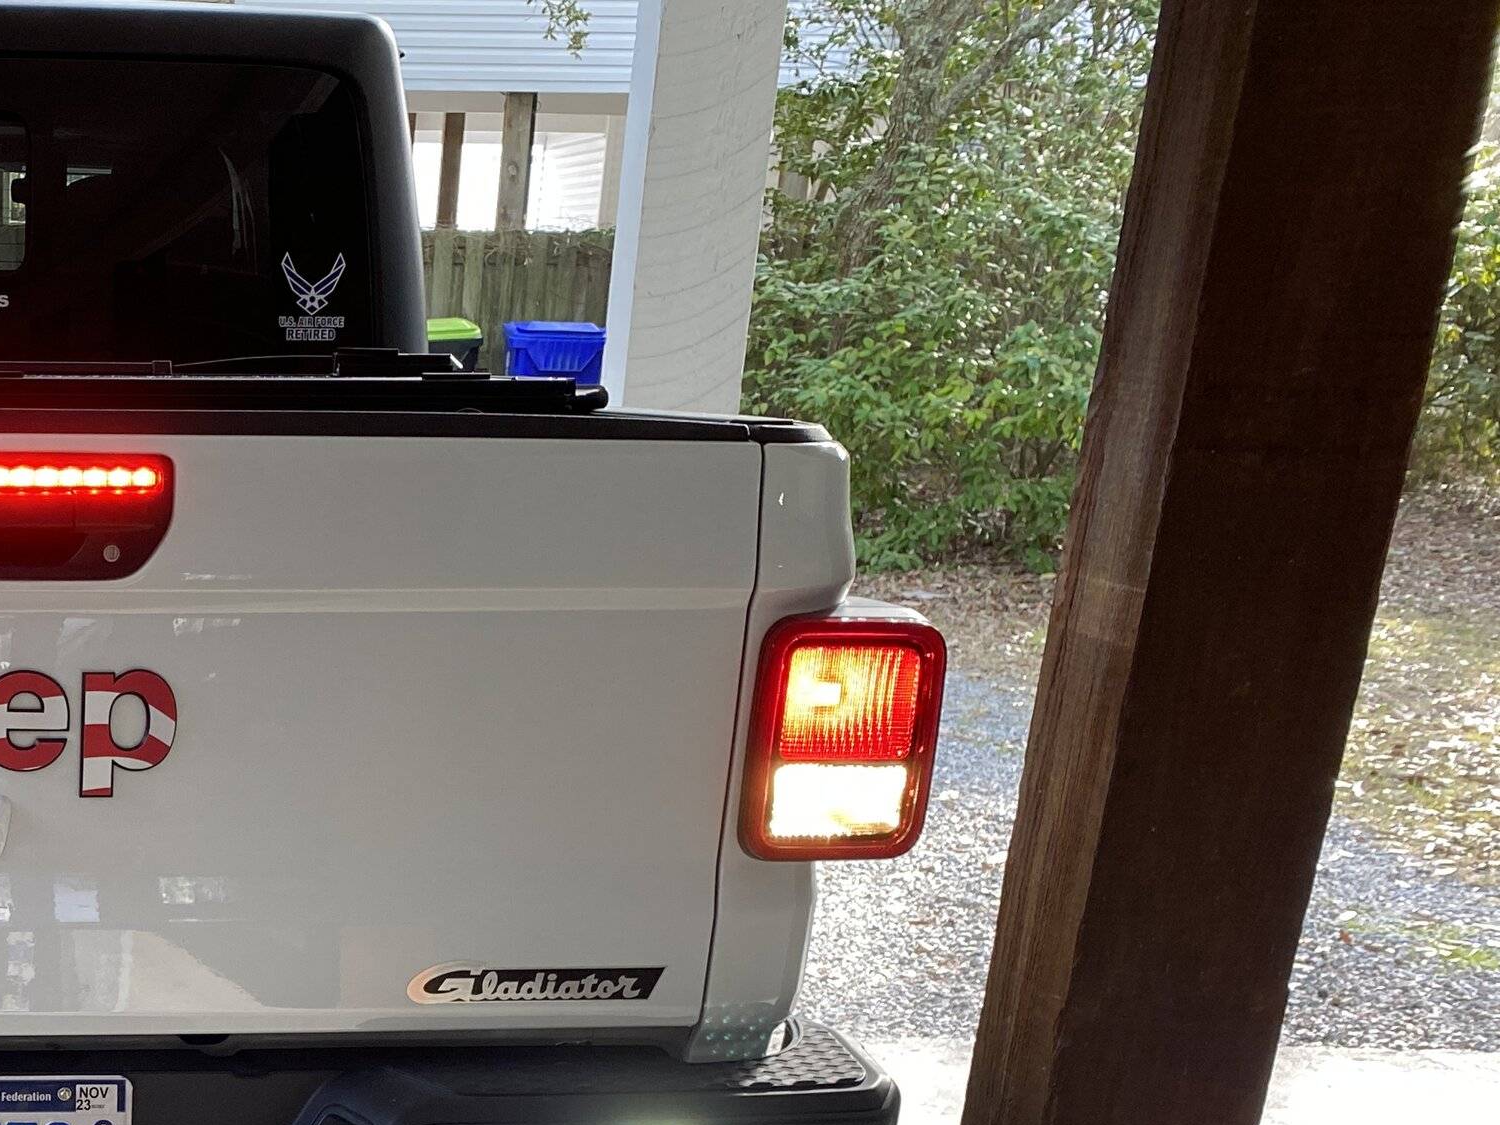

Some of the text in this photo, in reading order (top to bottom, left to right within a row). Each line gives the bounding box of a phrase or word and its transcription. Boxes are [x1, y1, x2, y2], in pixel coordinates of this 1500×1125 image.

[278, 316, 345, 328] U.S. AIR FORCE
[285, 328, 336, 341] RETIRED
[406, 960, 642, 1005] Gladiator
[1, 1091, 51, 1102] Federation
[79, 1086, 109, 1099] NOV
[76, 1099, 91, 1111] 23
